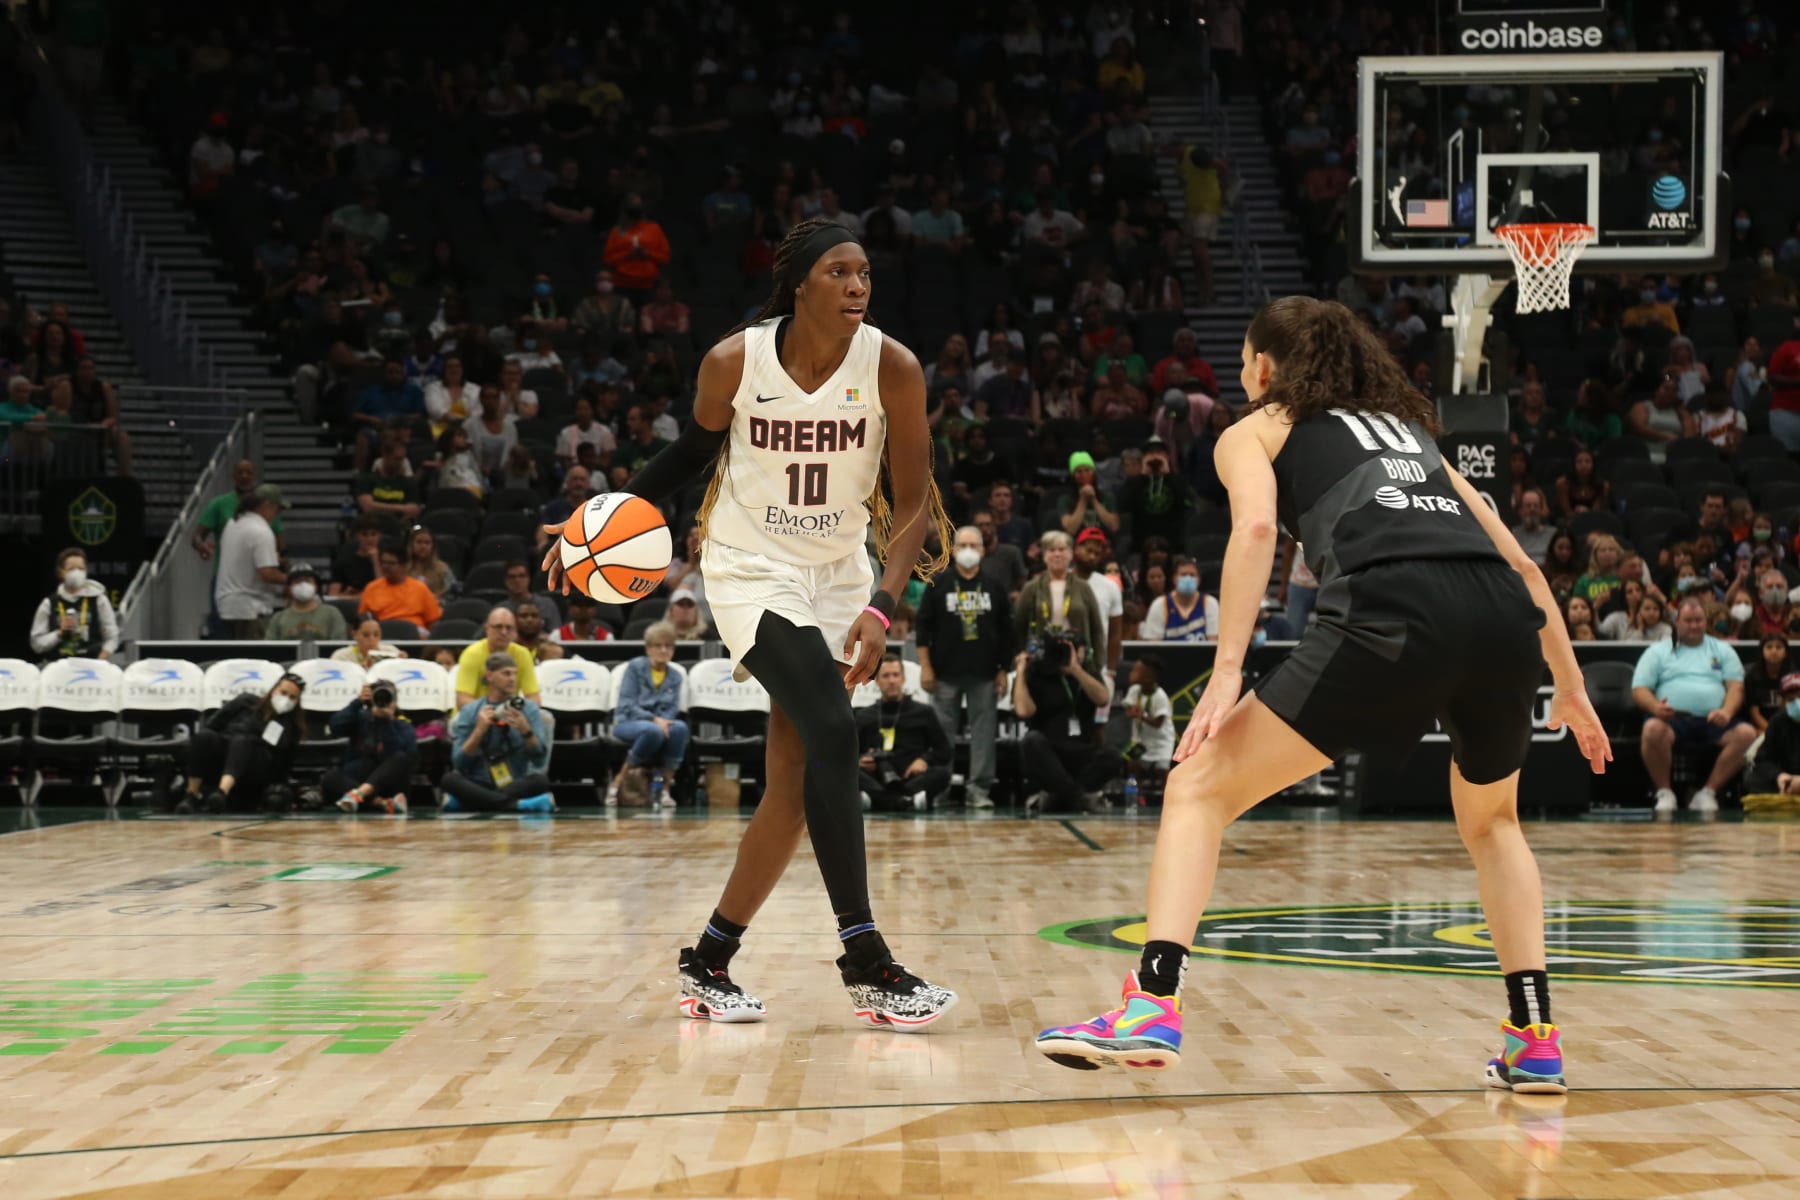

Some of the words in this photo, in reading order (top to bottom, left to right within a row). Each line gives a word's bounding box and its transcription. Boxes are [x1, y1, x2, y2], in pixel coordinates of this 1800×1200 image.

[1461, 20, 1603, 49] coinbase
[1647, 211, 1690, 229] AT&T
[837, 403, 867, 411] Microsoft
[750, 415, 867, 452] DREAM
[1326, 407, 1423, 454] 10
[1457, 444, 1496, 461] PAC
[1380, 457, 1427, 483] BIRD
[1457, 461, 1496, 478] SCI
[785, 462, 828, 506] 10
[764, 505, 846, 531] EMORY
[1411, 494, 1461, 516] AT&T
